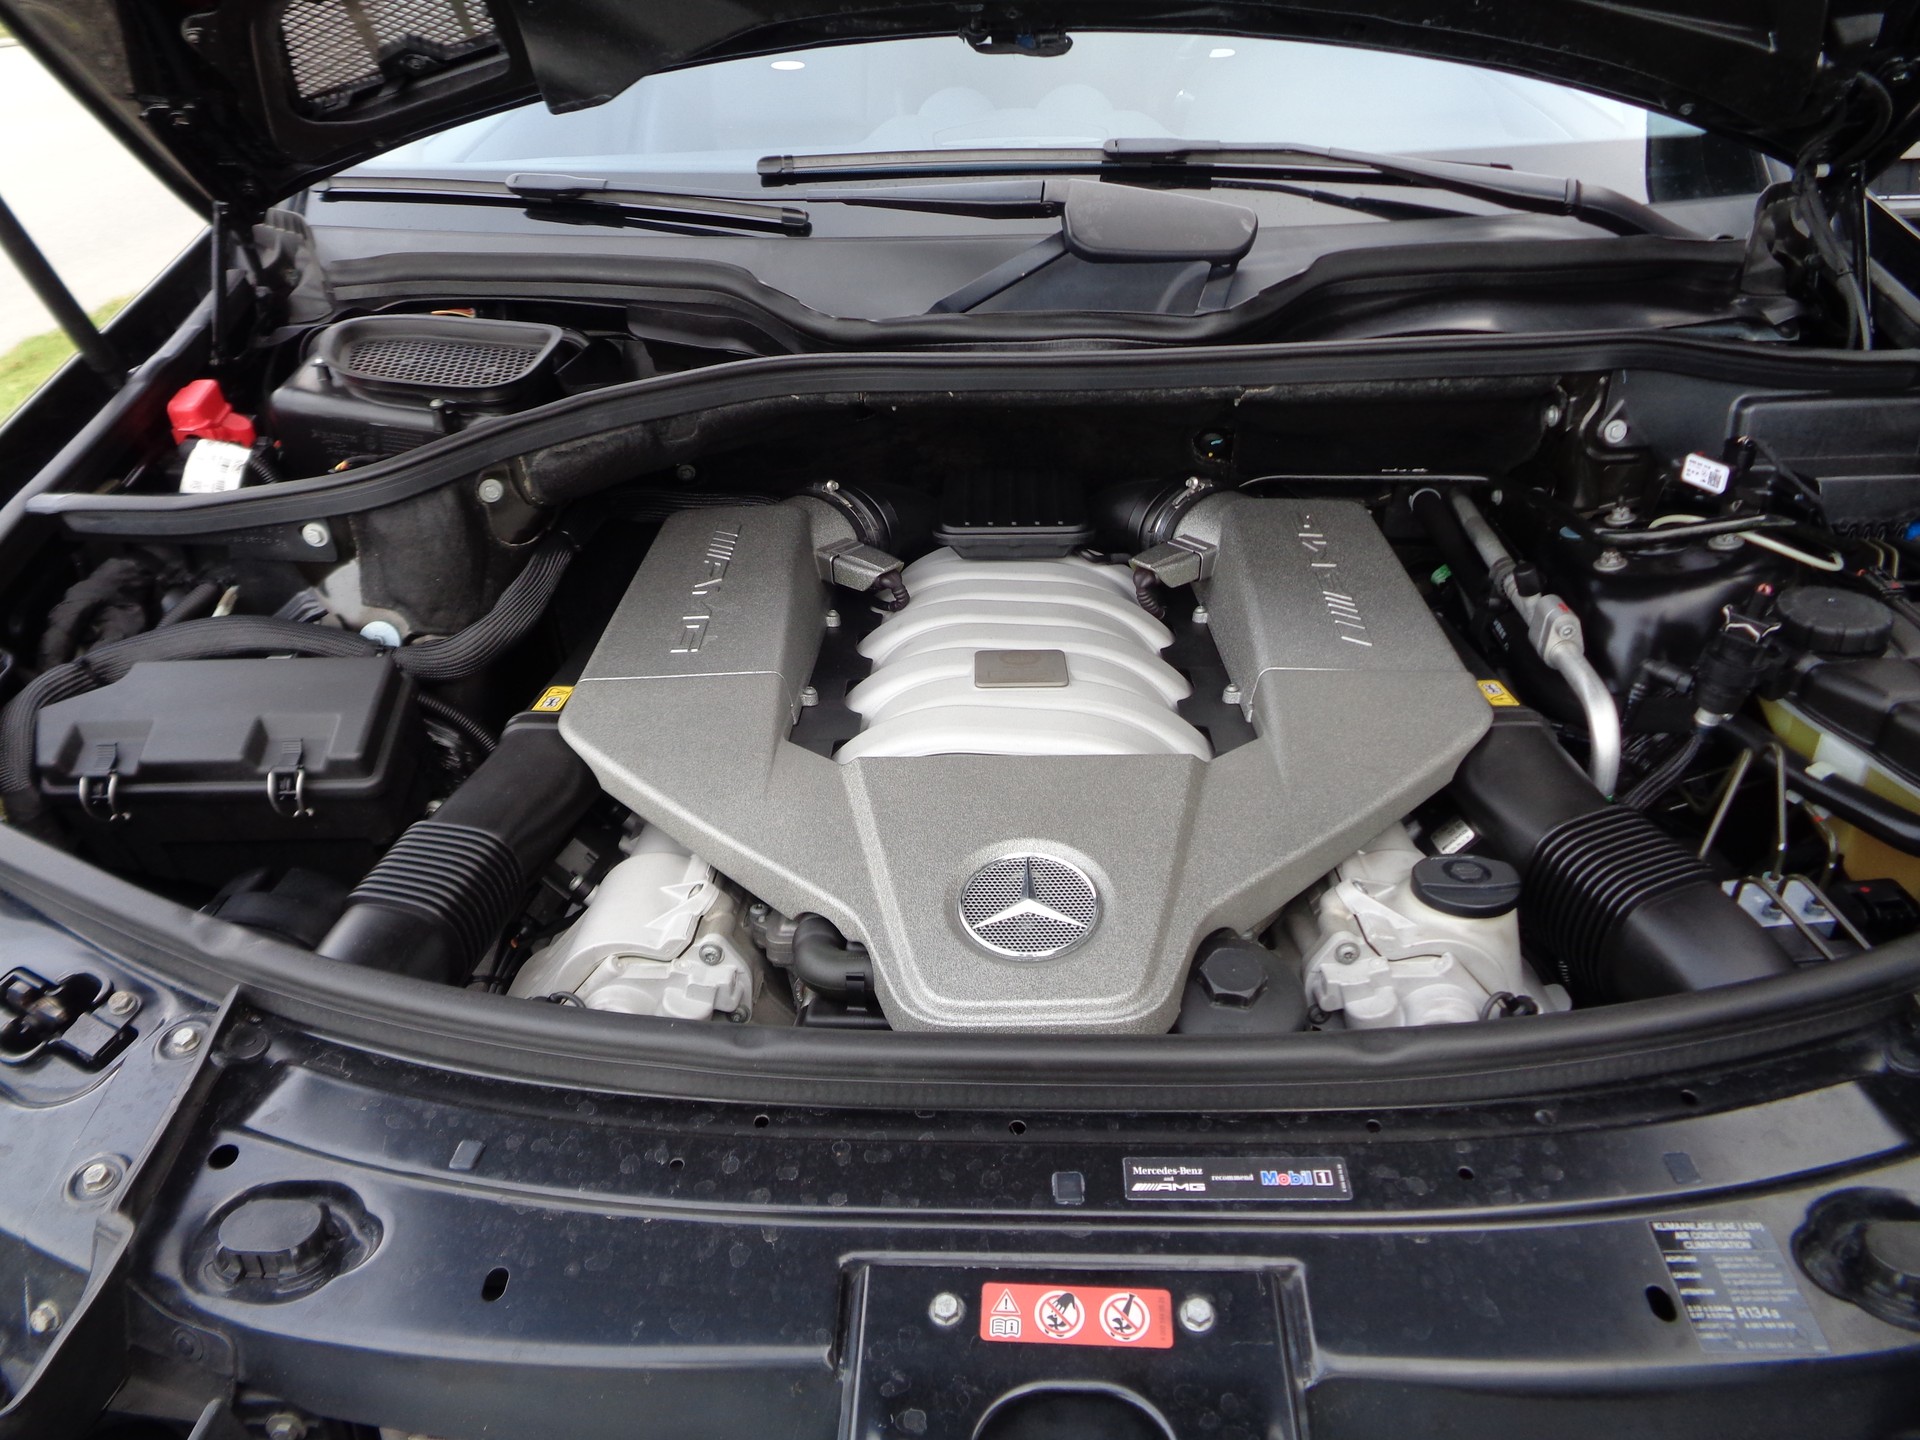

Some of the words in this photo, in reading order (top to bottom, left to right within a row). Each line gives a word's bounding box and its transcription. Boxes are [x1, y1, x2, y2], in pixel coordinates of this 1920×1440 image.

[1132, 1166, 1203, 1176] Mercedes-Benz
[1211, 1173, 1254, 1182] recommend
[1259, 1170, 1313, 1187] Mobil
